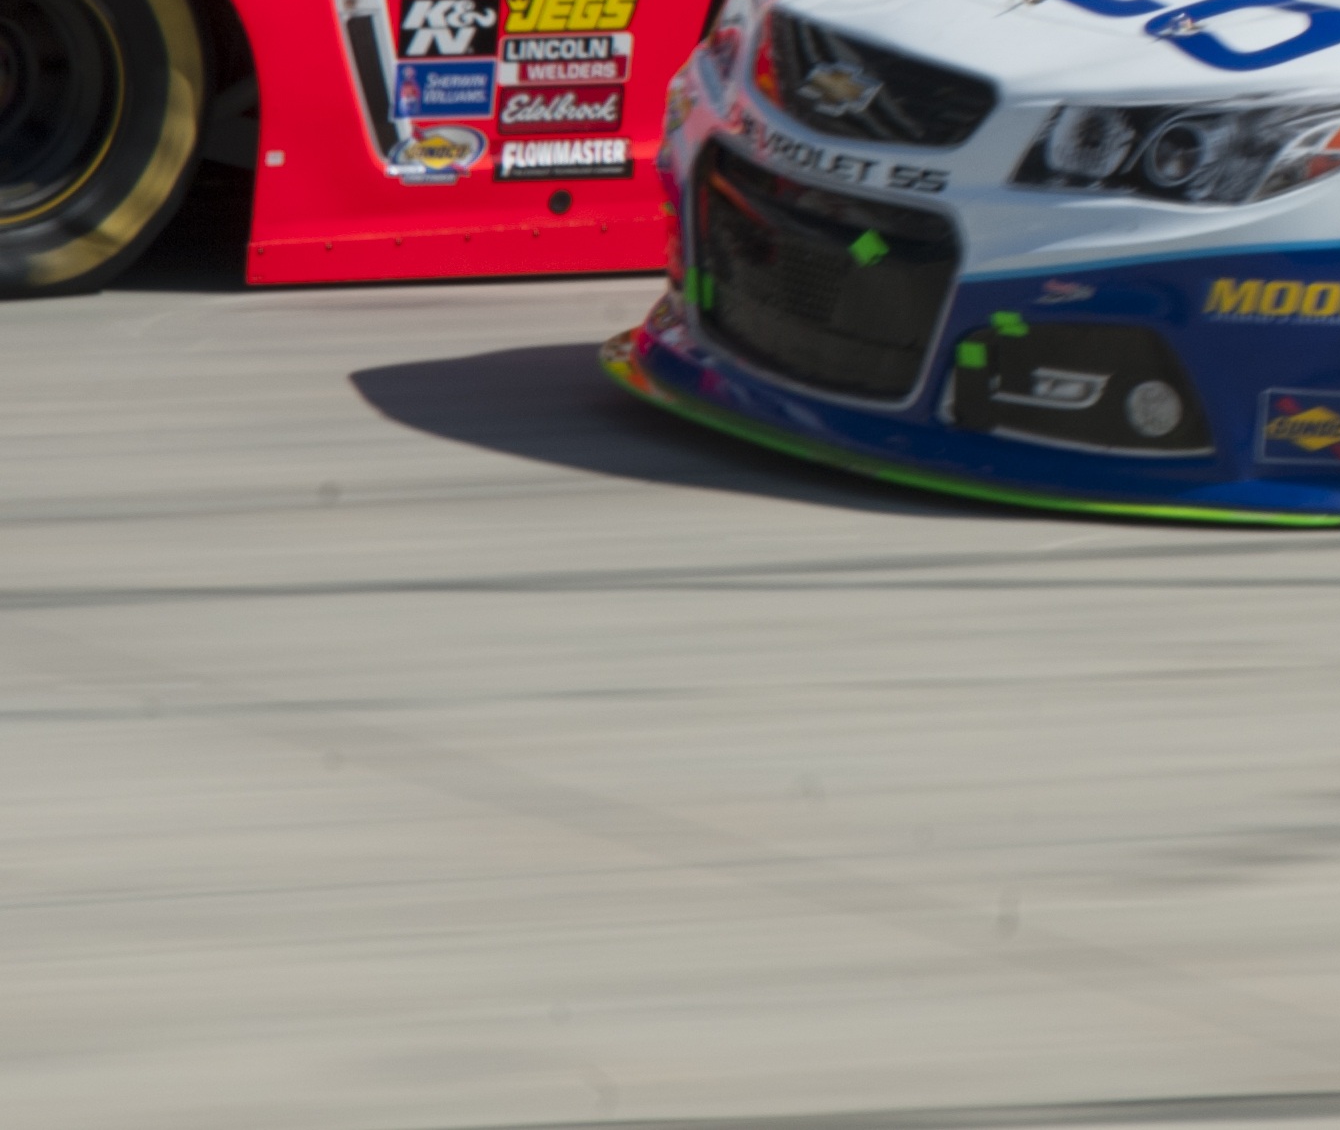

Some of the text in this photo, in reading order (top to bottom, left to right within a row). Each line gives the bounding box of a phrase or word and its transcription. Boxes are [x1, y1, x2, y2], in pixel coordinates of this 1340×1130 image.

[506, 38, 609, 61] LINCOLN
[526, 61, 617, 81] WELDERS
[502, 91, 618, 122] Edelbrock
[501, 139, 628, 177] FLOWMASTER
[887, 165, 951, 193] SS
